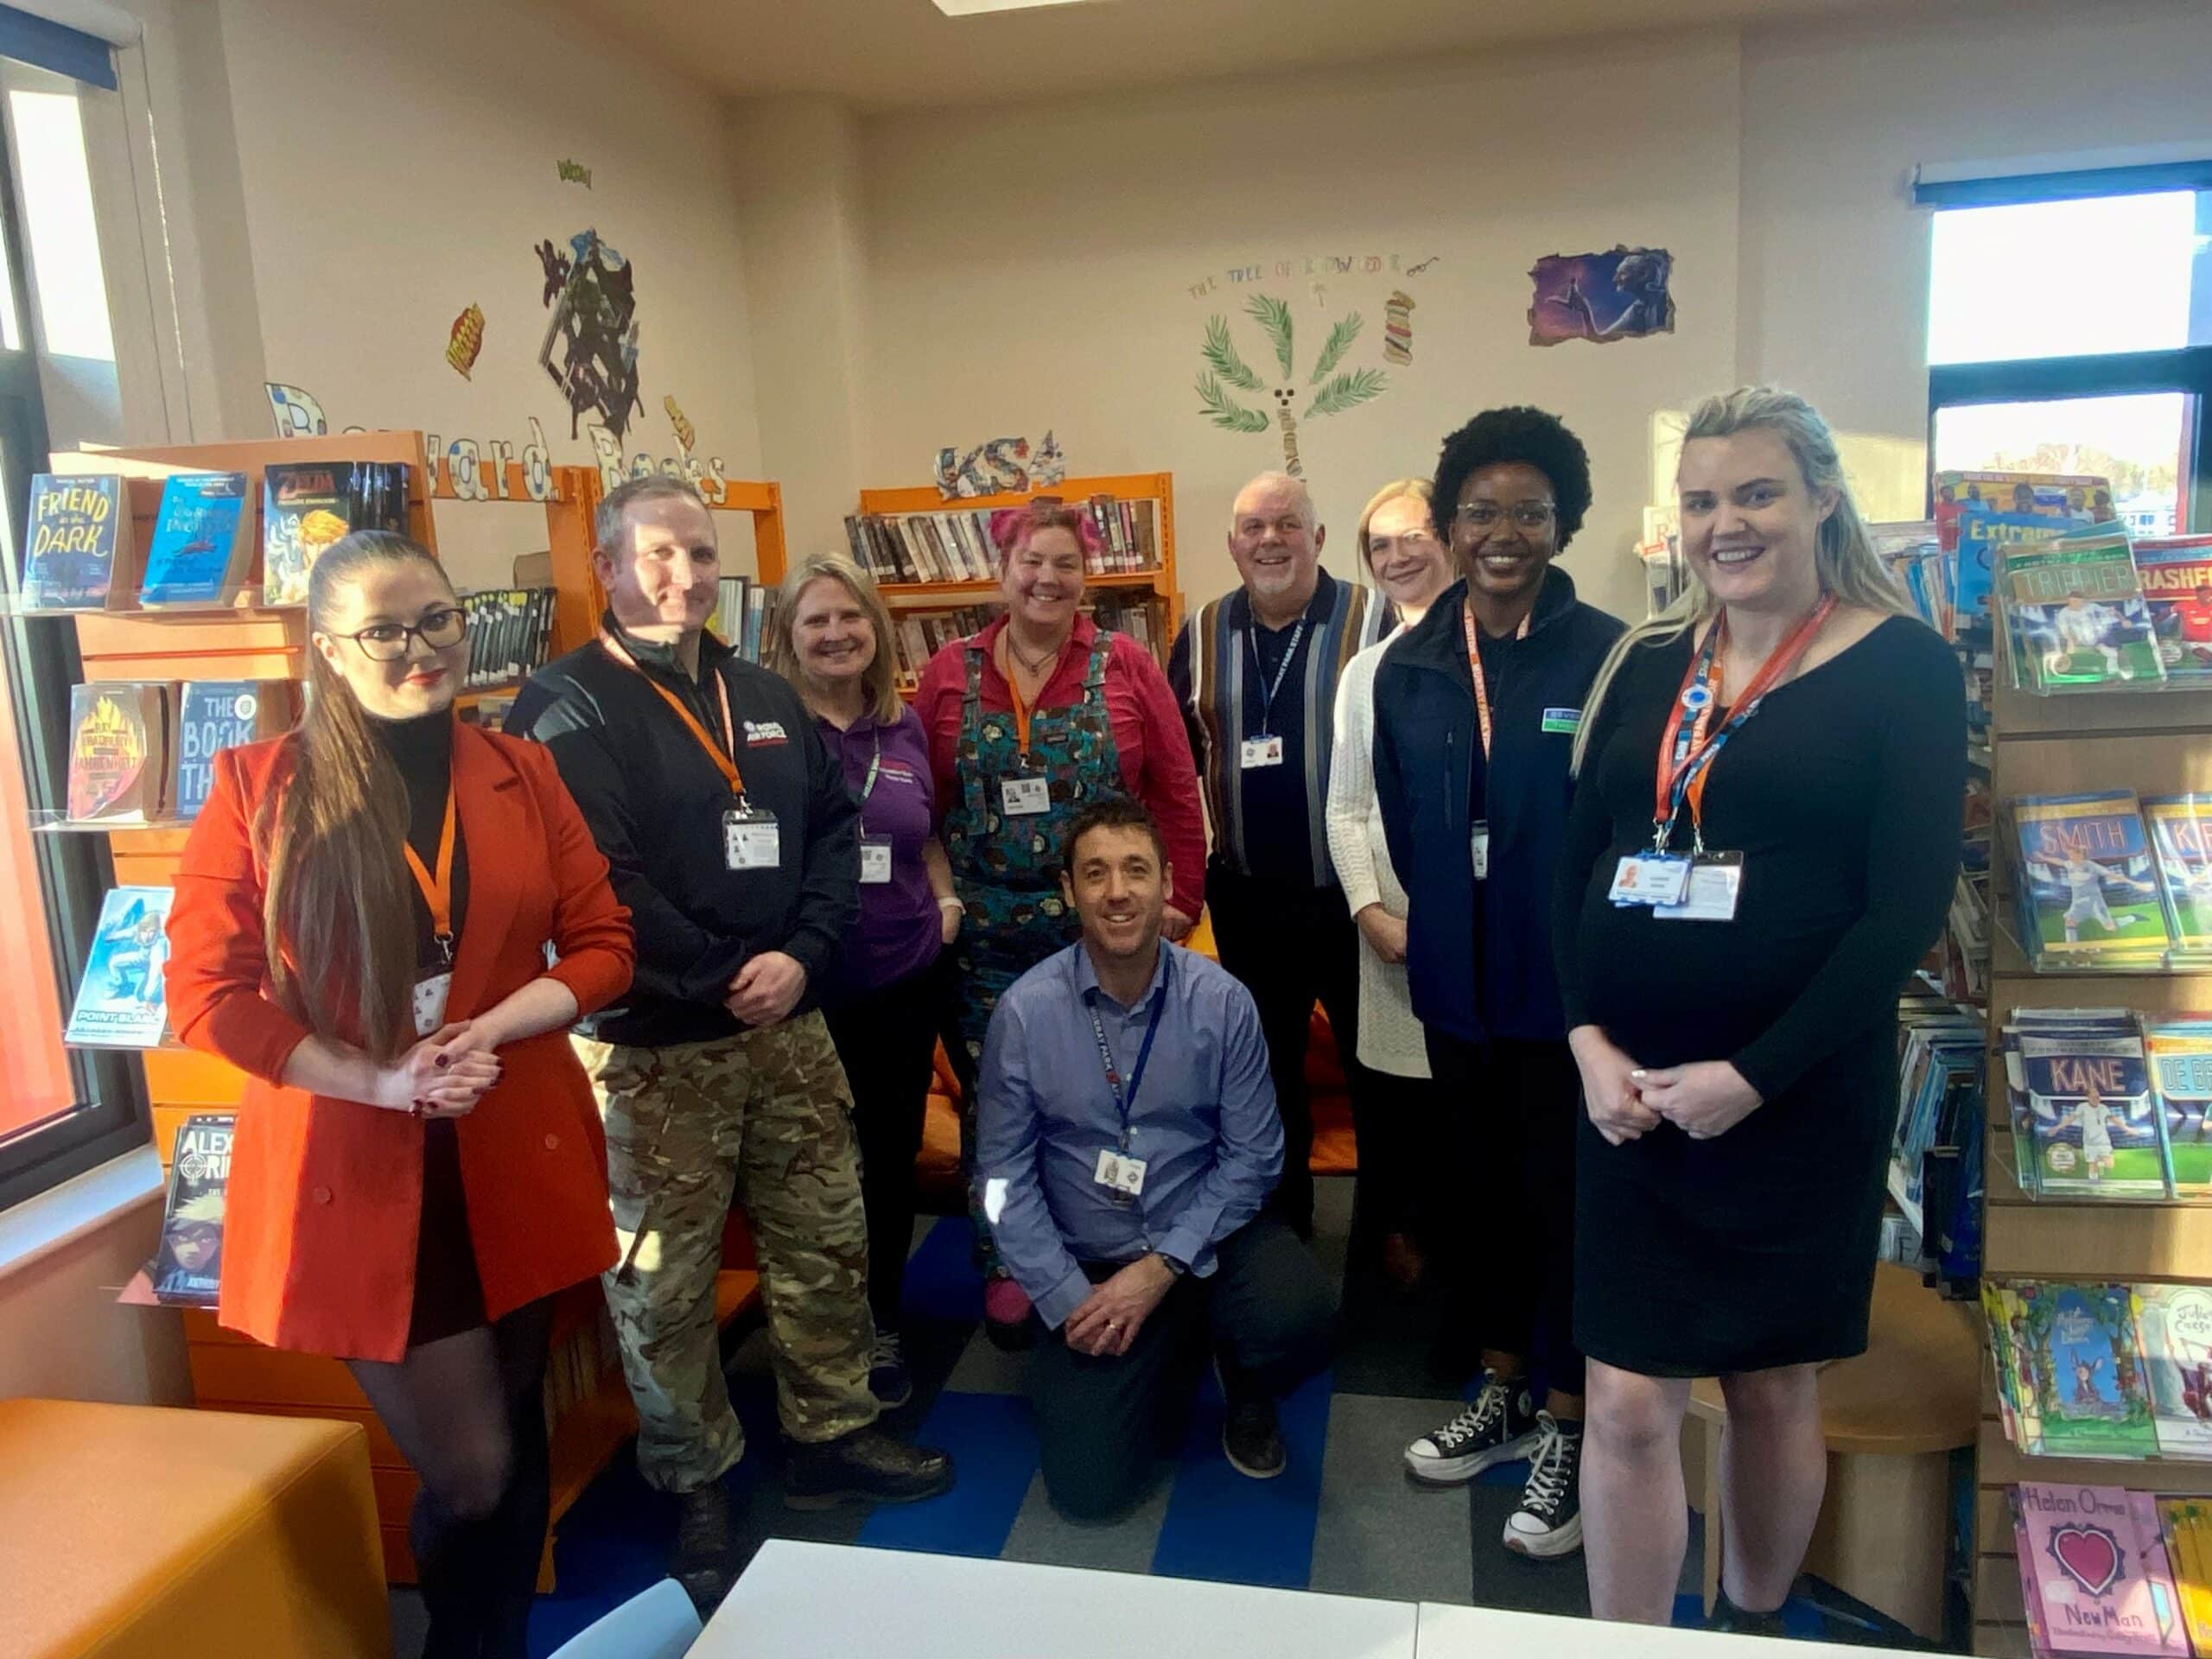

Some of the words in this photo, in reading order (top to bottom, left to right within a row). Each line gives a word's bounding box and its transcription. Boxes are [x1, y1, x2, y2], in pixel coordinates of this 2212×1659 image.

[1188, 275, 1217, 300] THE
[264, 382, 558, 503] Rard
[37, 486, 110, 523] FRIEND
[33, 524, 109, 558] DARK
[2022, 565, 2131, 598] TRIPPIER
[204, 696, 236, 717] THE
[181, 763, 213, 800] TH
[2040, 822, 2126, 853] SMITH
[2049, 1058, 2126, 1092] KANE
[2161, 1058, 2189, 1091] DE
[181, 1130, 234, 1154] ALEX
[205, 1154, 232, 1179] RI
[2024, 1487, 2076, 1512] Helen
[2064, 1603, 2101, 1626] New
[2102, 1605, 2144, 1628] Man
